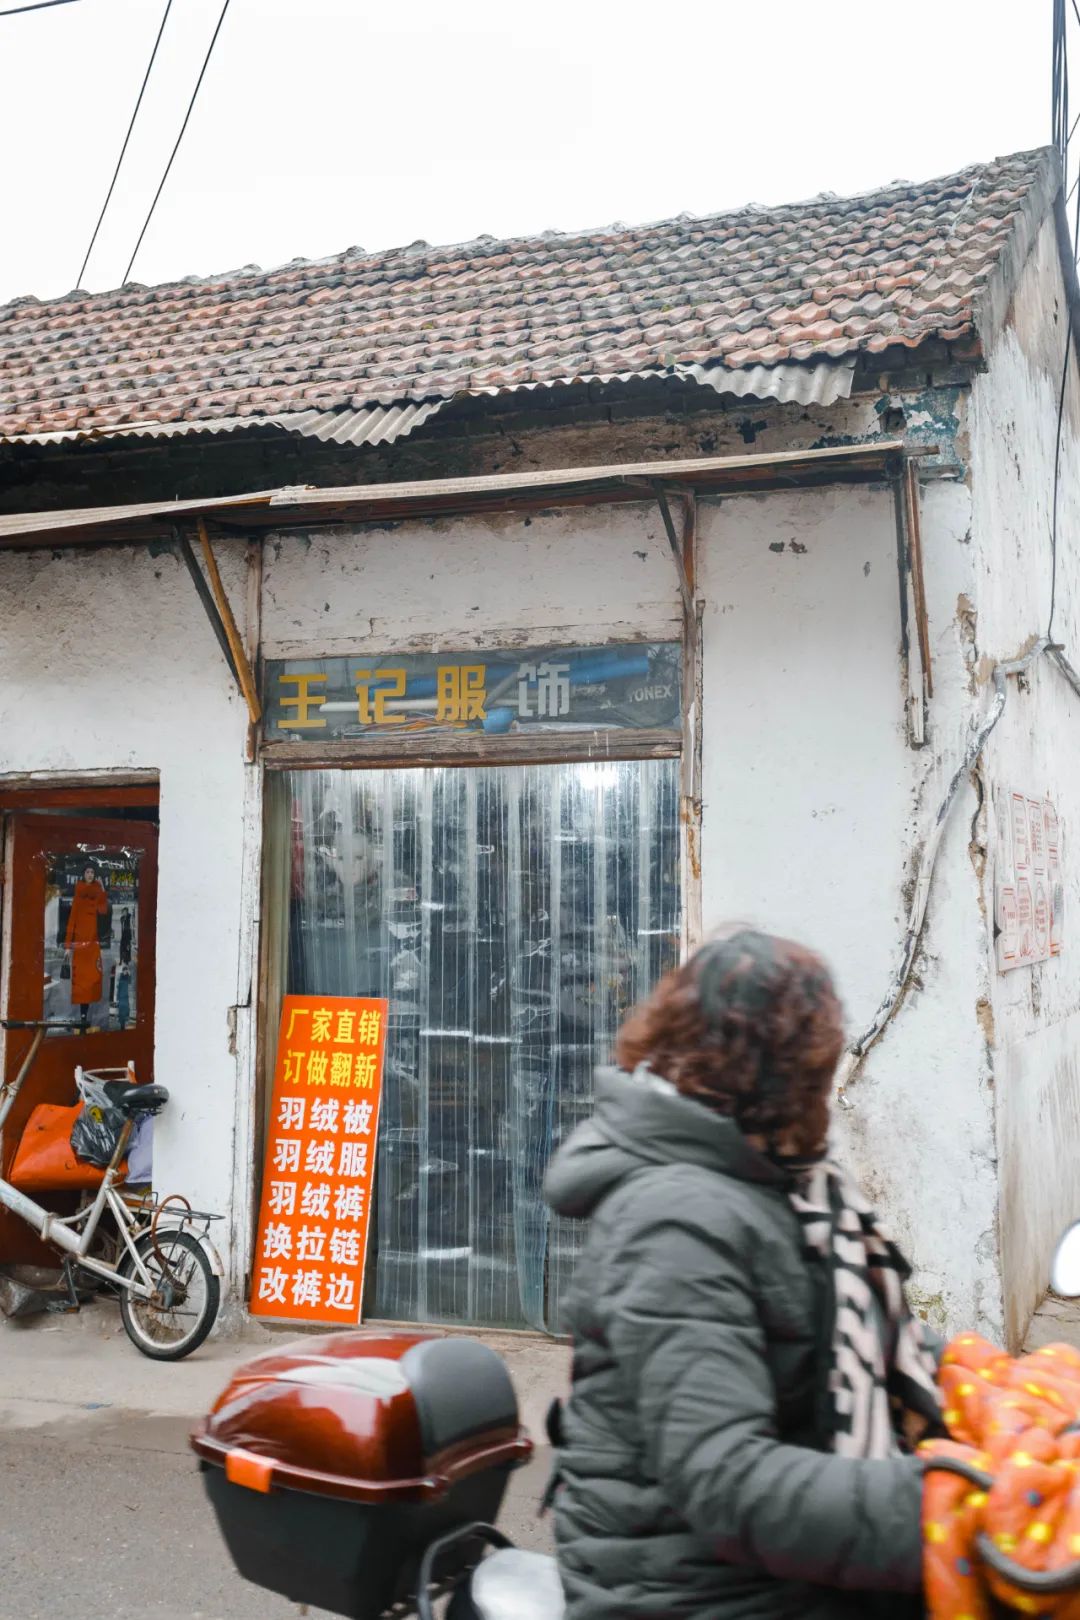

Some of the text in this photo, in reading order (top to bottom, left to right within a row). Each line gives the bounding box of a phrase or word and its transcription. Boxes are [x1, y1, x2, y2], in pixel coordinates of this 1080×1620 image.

[278, 662, 570, 729] 王记服饰
[286, 1007, 382, 1046] 厂家直销
[283, 1049, 378, 1089] 订做翻新
[277, 1096, 373, 1136] 羽绒被
[272, 1138, 368, 1178] 羽绒服
[268, 1180, 365, 1222] 羽绒裤
[263, 1222, 361, 1266] 换拉链
[258, 1266, 356, 1310] 改裤边
